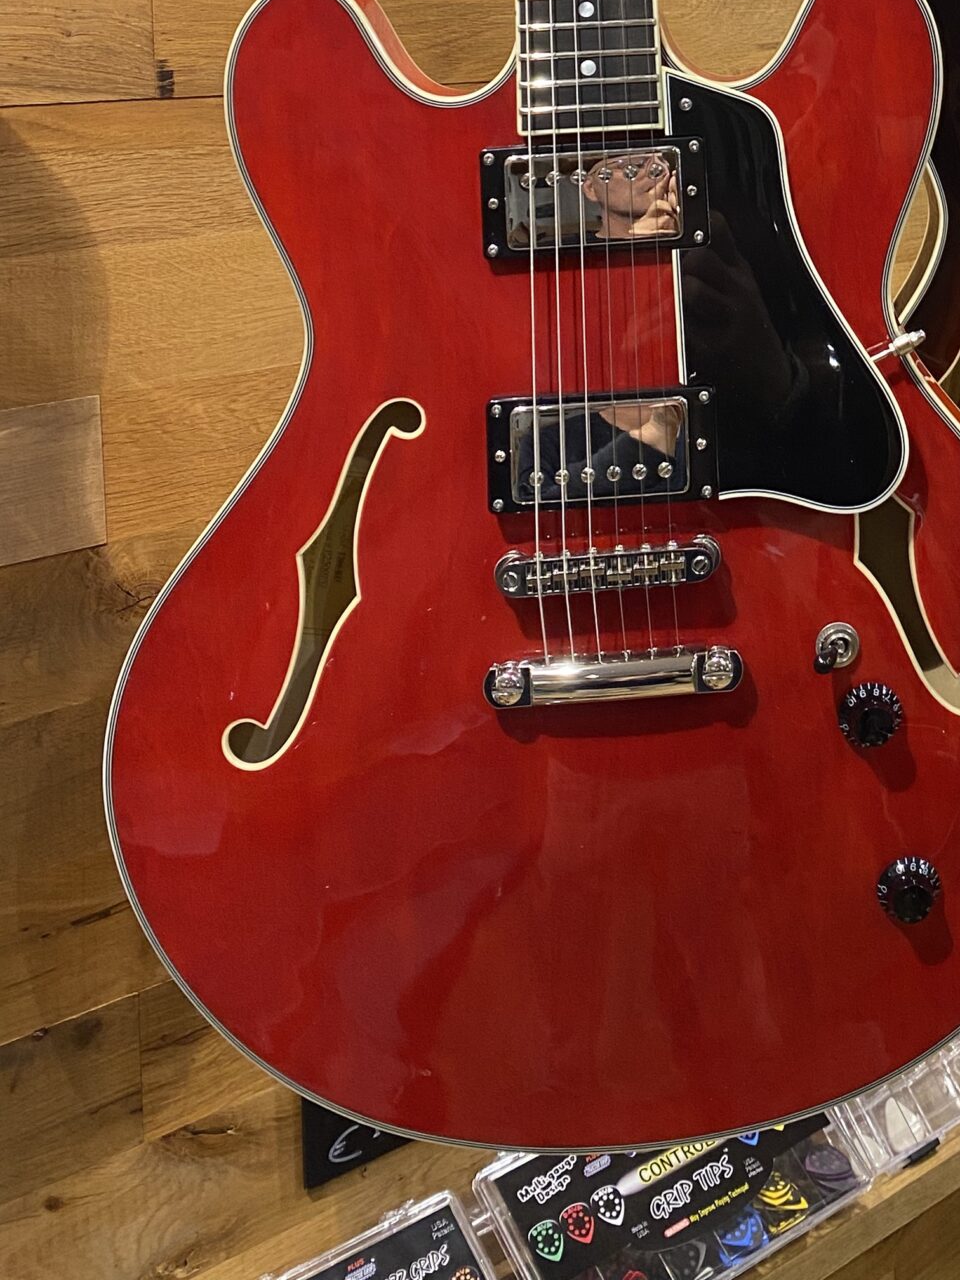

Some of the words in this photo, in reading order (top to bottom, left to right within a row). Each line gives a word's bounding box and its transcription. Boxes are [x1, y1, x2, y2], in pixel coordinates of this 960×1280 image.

[535, 1175, 571, 1204] Design
[650, 1180, 693, 1219] GRIP
[692, 1154, 734, 1191] TIPS
[408, 1243, 450, 1280] GRIPS
